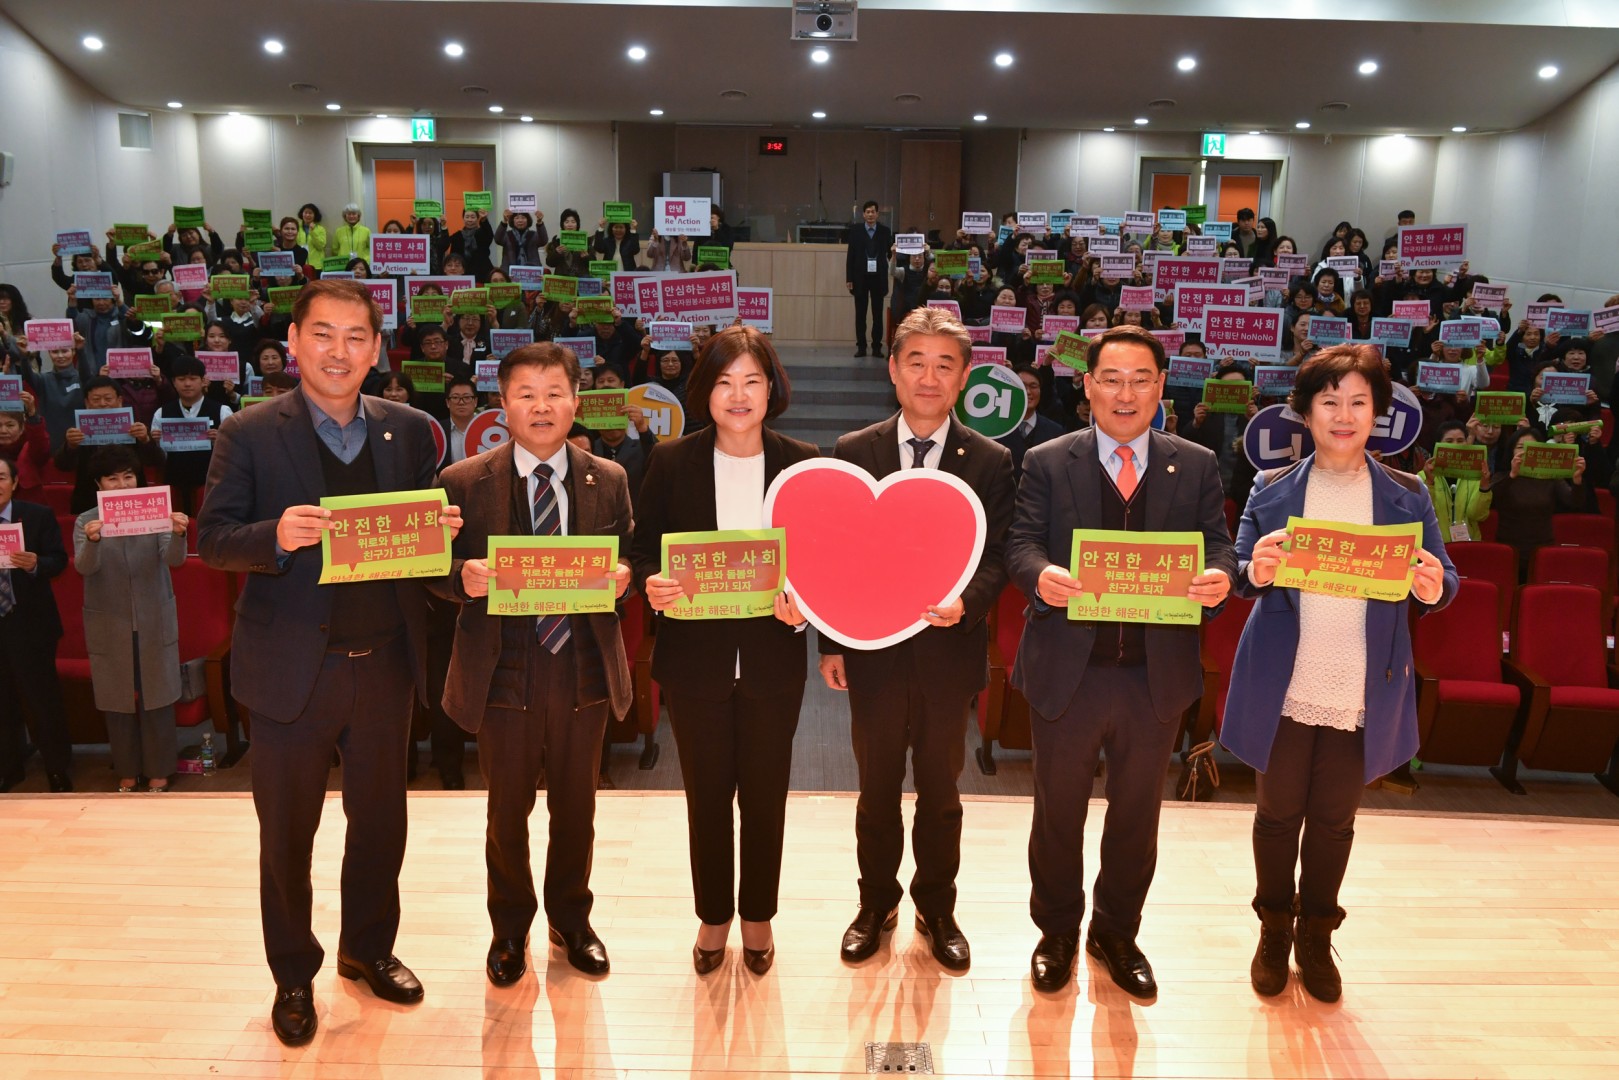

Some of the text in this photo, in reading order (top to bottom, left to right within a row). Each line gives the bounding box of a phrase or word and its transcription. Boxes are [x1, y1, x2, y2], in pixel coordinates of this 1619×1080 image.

[767, 142, 783, 151] 3:52
[668, 205, 683, 213] 안녕
[1403, 232, 1462, 245] 안전한 사회
[376, 242, 424, 251] 안전한 사회
[1414, 259, 1441, 267] Action
[1160, 265, 1217, 277] 안전한 사회
[372, 289, 390, 301] 사회
[664, 281, 731, 298] 안심하는 사회
[665, 296, 731, 308] 전국자원봉사공동행동
[750, 296, 767, 307] 사회
[1181, 293, 1243, 305] 안전한 사회
[680, 314, 710, 323] Action
[1211, 316, 1245, 329] 안전한
[1253, 318, 1275, 331] 사회
[57, 324, 70, 332] 사회
[1177, 321, 1188, 329] Re
[1209, 331, 1274, 342] 무단횡단 NoNoNo
[1220, 347, 1251, 357] Action
[608, 397, 623, 405] 사회
[963, 383, 1012, 419] 여
[115, 415, 129, 424] 사회
[104, 496, 165, 512] 안심하는 사회
[334, 509, 438, 538] 안전한 사회
[358, 532, 420, 549] 위로와 돌봄의
[1295, 533, 1409, 559] 안전한 사회
[363, 545, 417, 561] 친구가 되자
[499, 555, 607, 568] 안전한 사회
[671, 548, 776, 571] 안전한 사회
[1082, 551, 1194, 572] 안전한 사회
[1316, 553, 1384, 569] 위로와 돌봄의
[330, 572, 365, 583] 안녕한
[368, 569, 403, 579] 해운대
[521, 568, 584, 577] 위로와 돌봄의
[695, 568, 756, 581] 위로와 돌봄의
[1318, 563, 1376, 578] 친구가 되자
[1104, 571, 1170, 583] 위로와 돌봄의
[526, 578, 579, 589] 친구가 되자
[699, 581, 752, 593] 친구가 되자
[1108, 583, 1164, 595] 친구가 되자
[1284, 577, 1357, 593] 안녕한 해운대
[498, 601, 530, 613] 안녕한
[534, 601, 567, 612] 해운대
[672, 605, 704, 618] 안녕한
[708, 604, 741, 616] 해운대
[1077, 605, 1111, 618] 안녕한
[1115, 607, 1150, 620] 해운대
